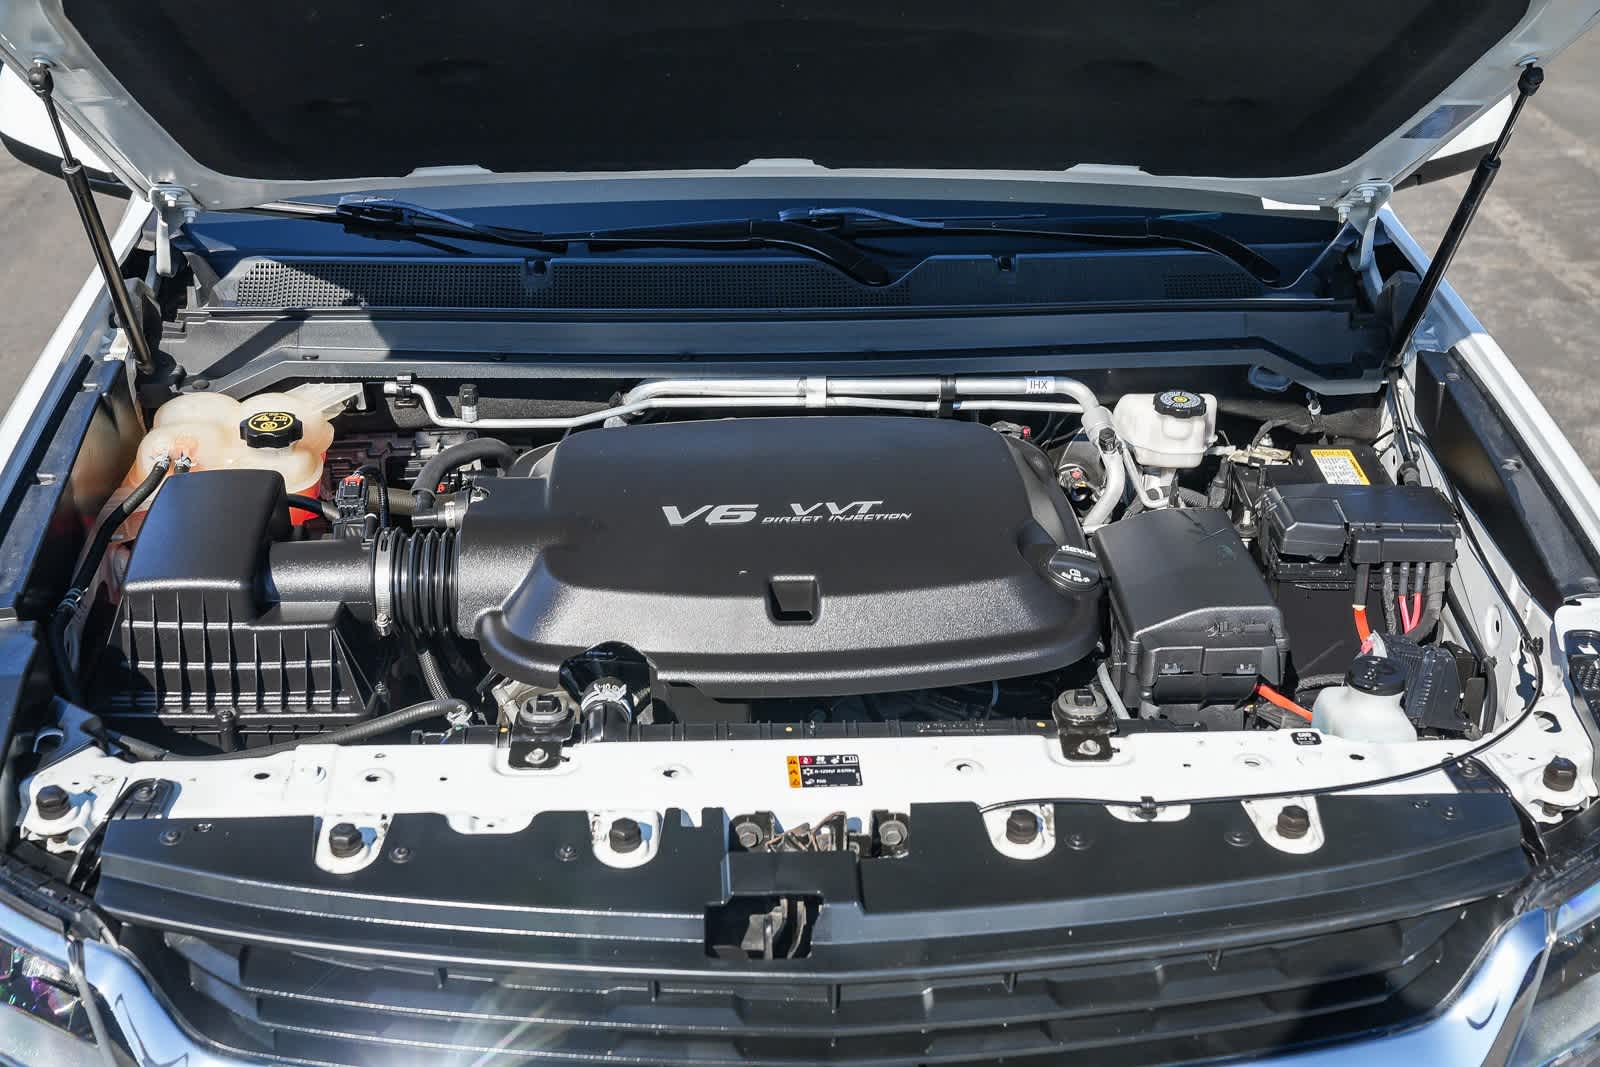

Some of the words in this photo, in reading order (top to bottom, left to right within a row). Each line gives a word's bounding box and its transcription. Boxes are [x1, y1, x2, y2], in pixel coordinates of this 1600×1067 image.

[661, 504, 759, 526] V6
[790, 500, 884, 515] VVT
[760, 515, 823, 524] DIRECT
[828, 513, 912, 522] INJECTION
